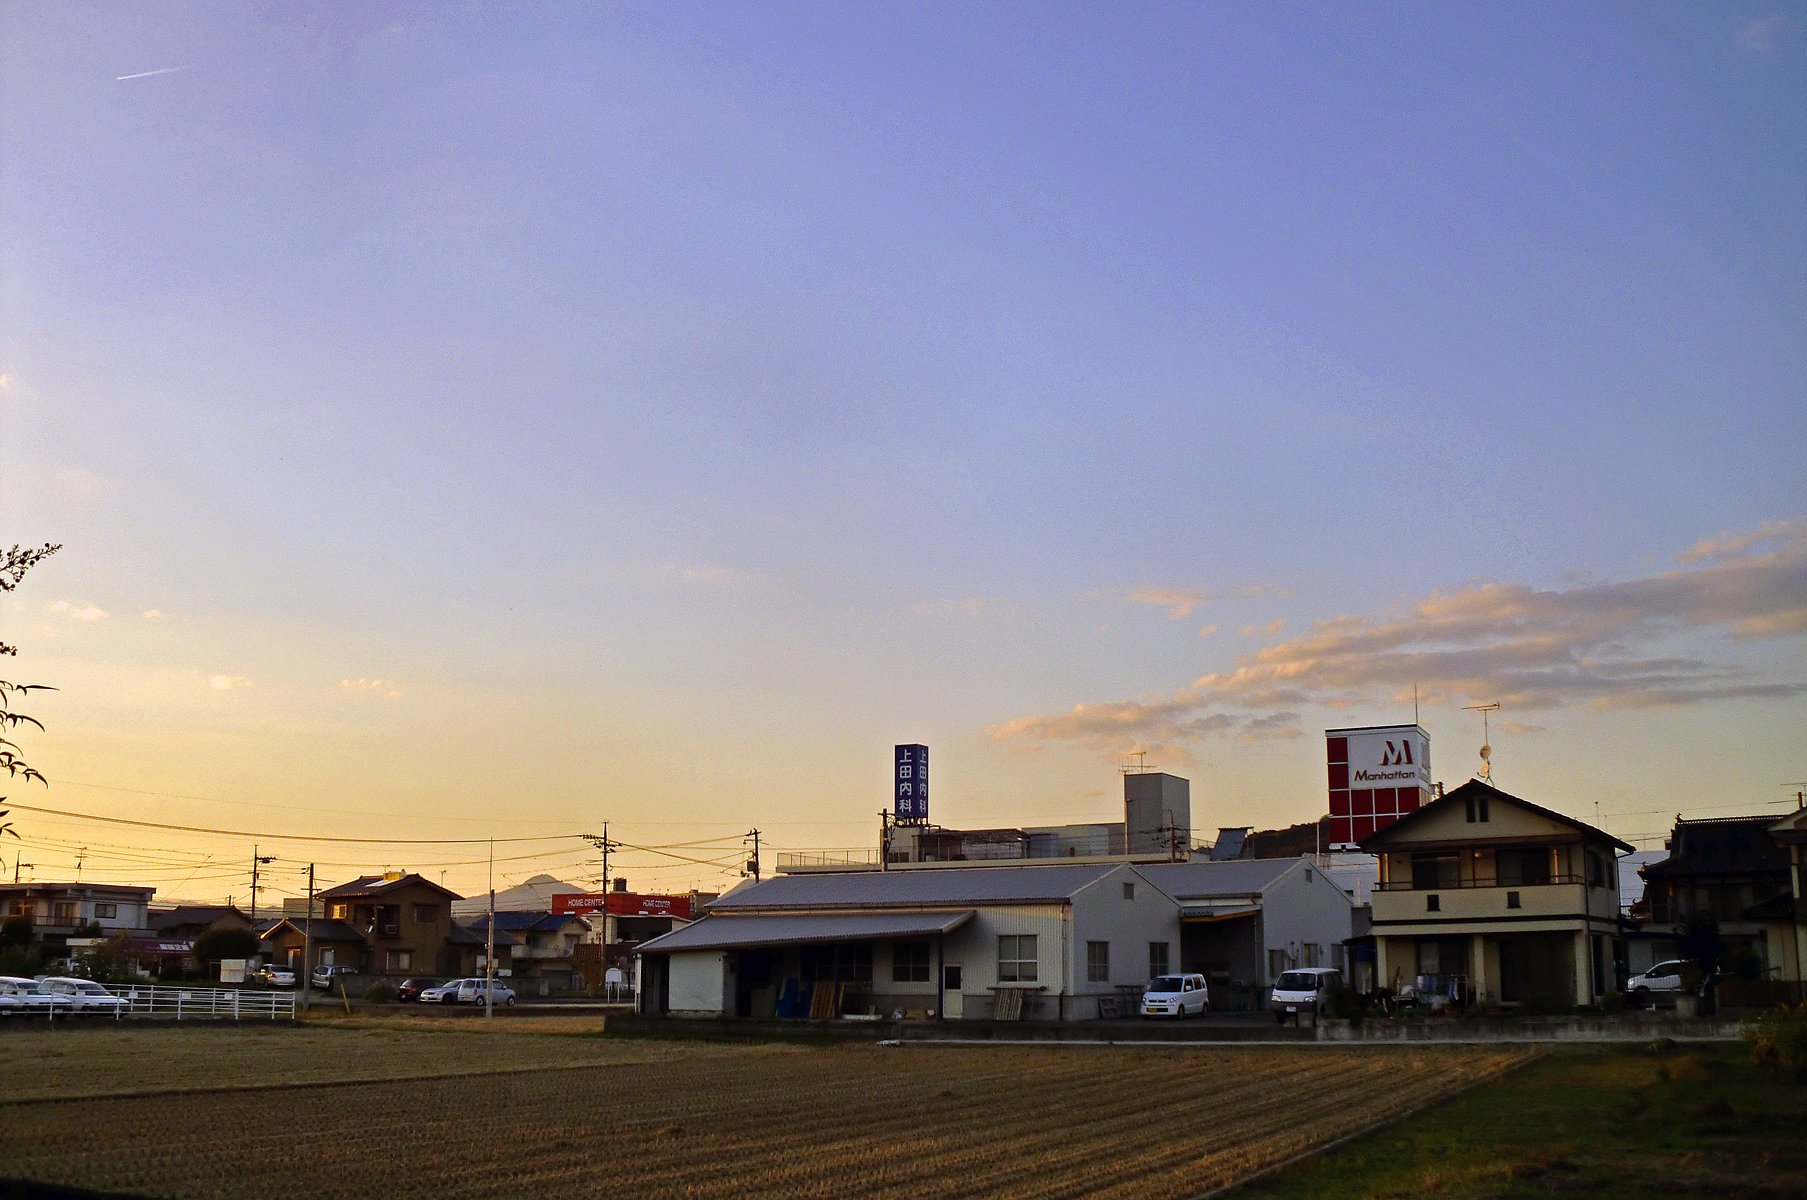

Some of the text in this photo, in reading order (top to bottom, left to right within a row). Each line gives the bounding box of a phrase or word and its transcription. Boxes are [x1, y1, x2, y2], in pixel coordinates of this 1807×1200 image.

[899, 748, 912, 813] 上田内科
[1354, 769, 1415, 781] Manhattan
